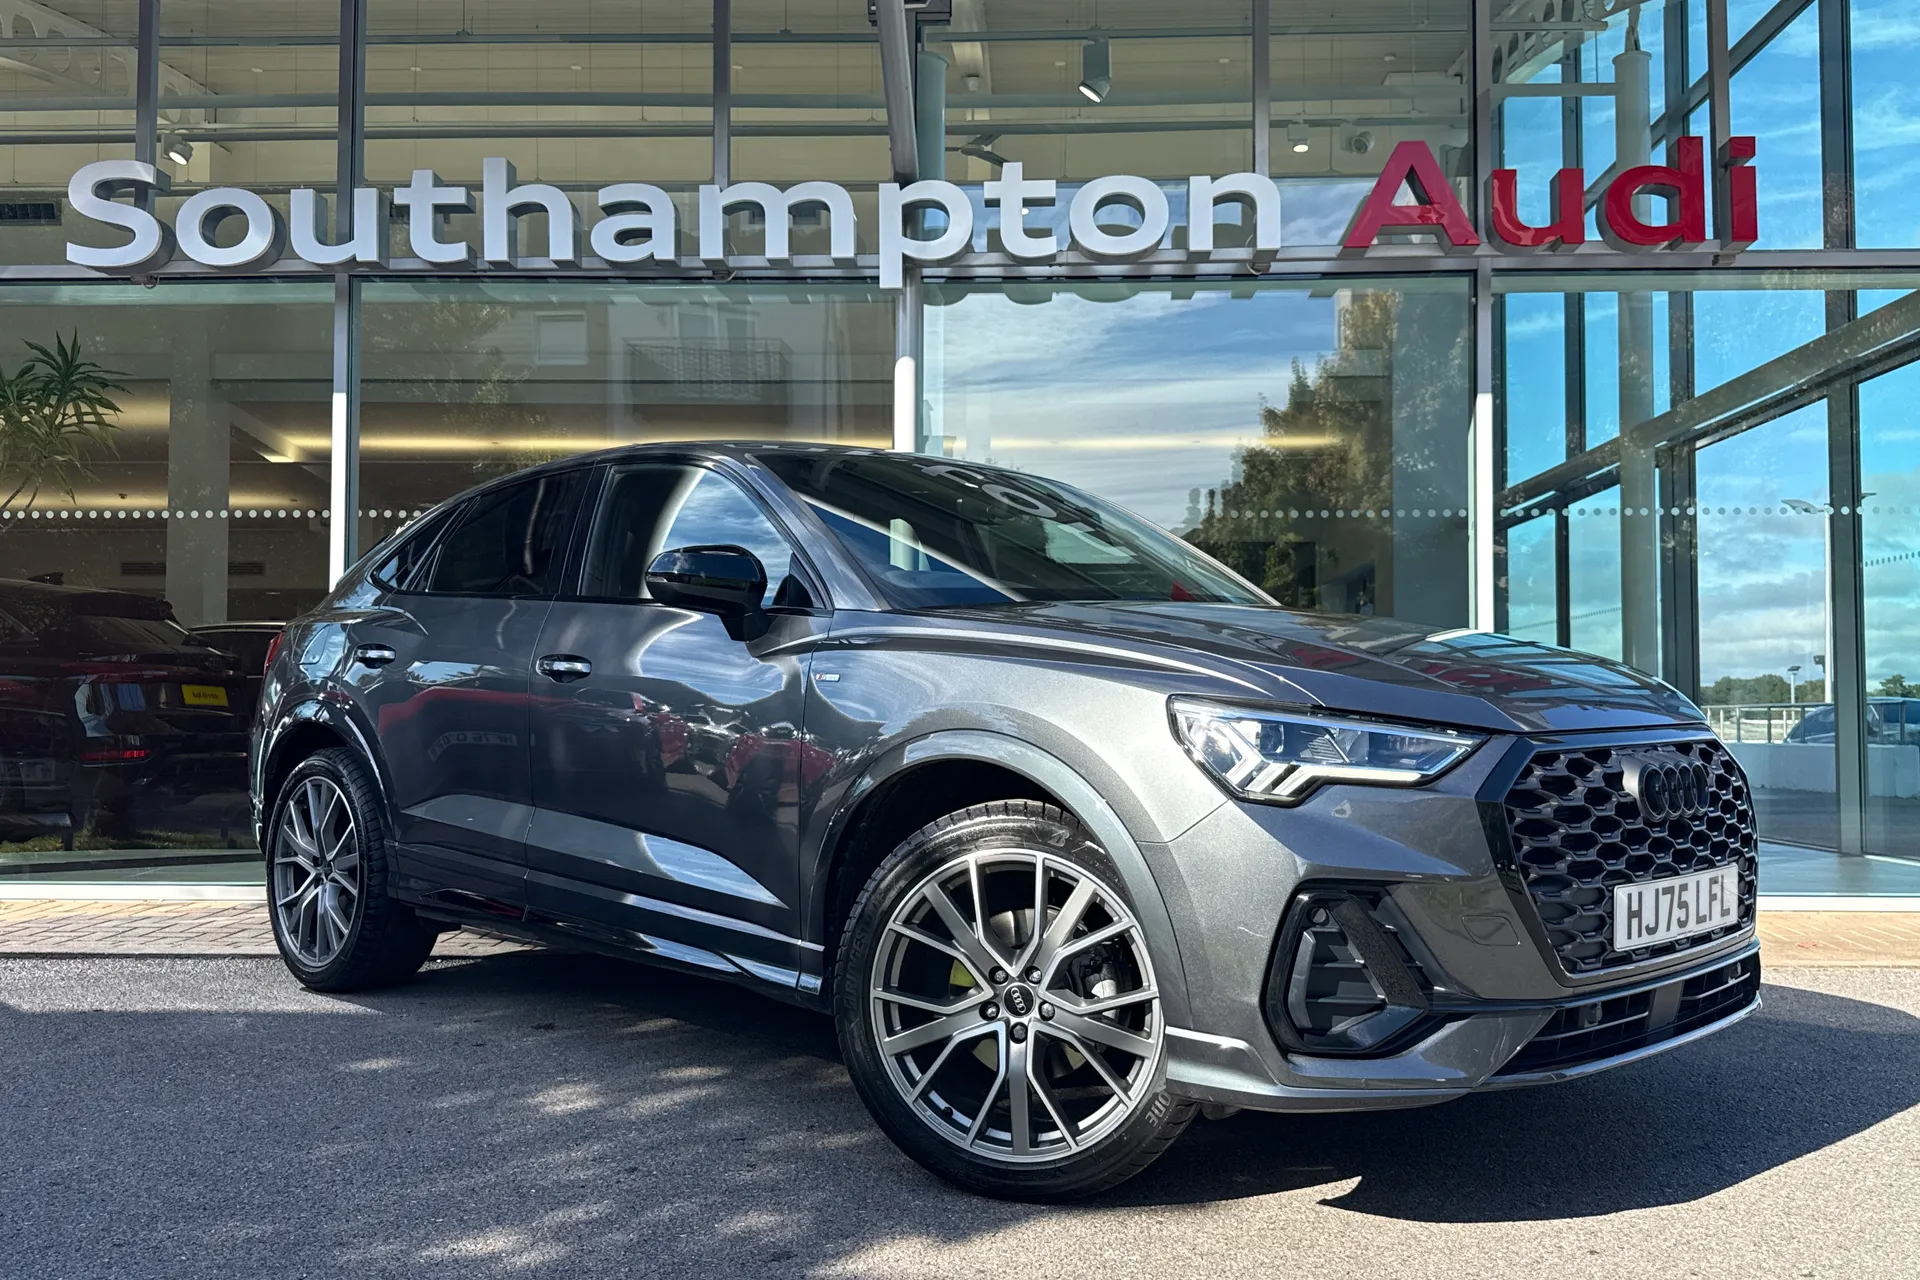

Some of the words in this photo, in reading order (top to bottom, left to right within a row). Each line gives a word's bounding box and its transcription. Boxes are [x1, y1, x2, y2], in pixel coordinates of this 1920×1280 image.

[66, 157, 1281, 289] Southampton
[1341, 136, 1759, 249] Audi
[1627, 883, 1689, 940] HJ75
[1695, 874, 1731, 925] LFL
[1145, 1090, 1171, 1127] ONE
